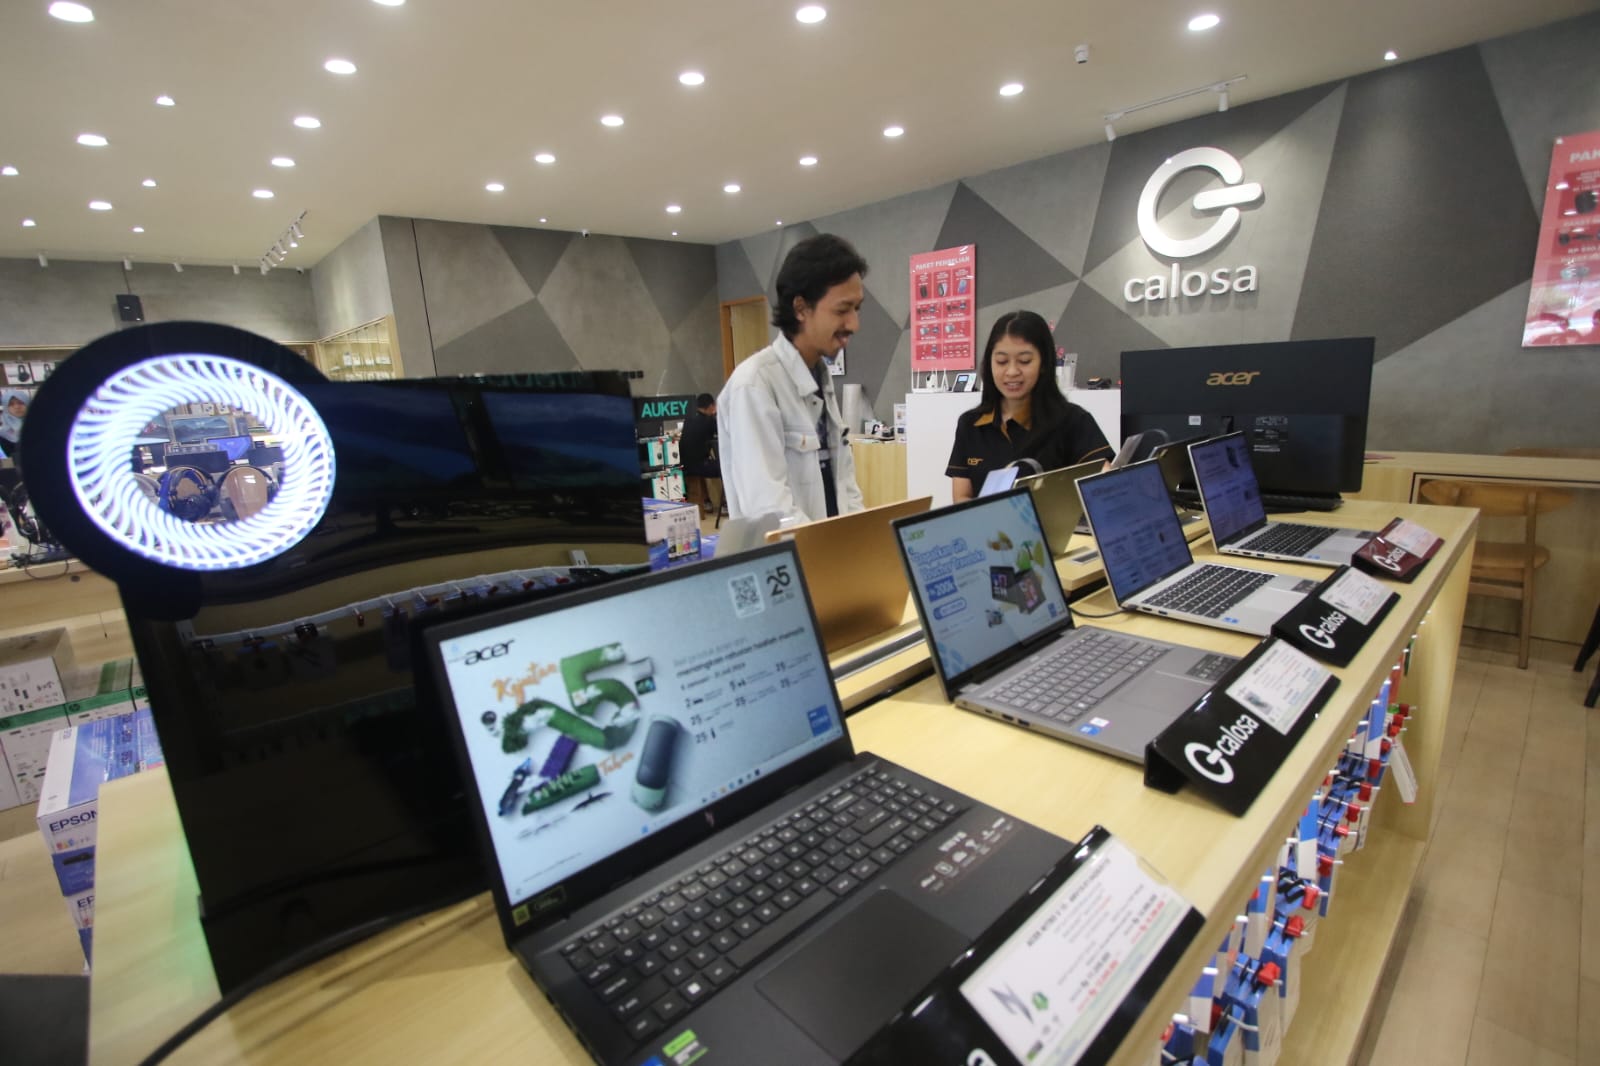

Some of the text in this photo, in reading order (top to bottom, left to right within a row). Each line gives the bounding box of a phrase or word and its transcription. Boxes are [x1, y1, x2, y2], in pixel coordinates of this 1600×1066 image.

[1124, 262, 1258, 303] calosa
[1205, 370, 1261, 386] acer
[641, 400, 688, 418] AUKEY
[966, 457, 984, 466] cer
[1319, 610, 1347, 634] calosa
[464, 637, 516, 665] acer
[1215, 714, 1260, 756] calosa
[49, 809, 98, 833] EPSON
